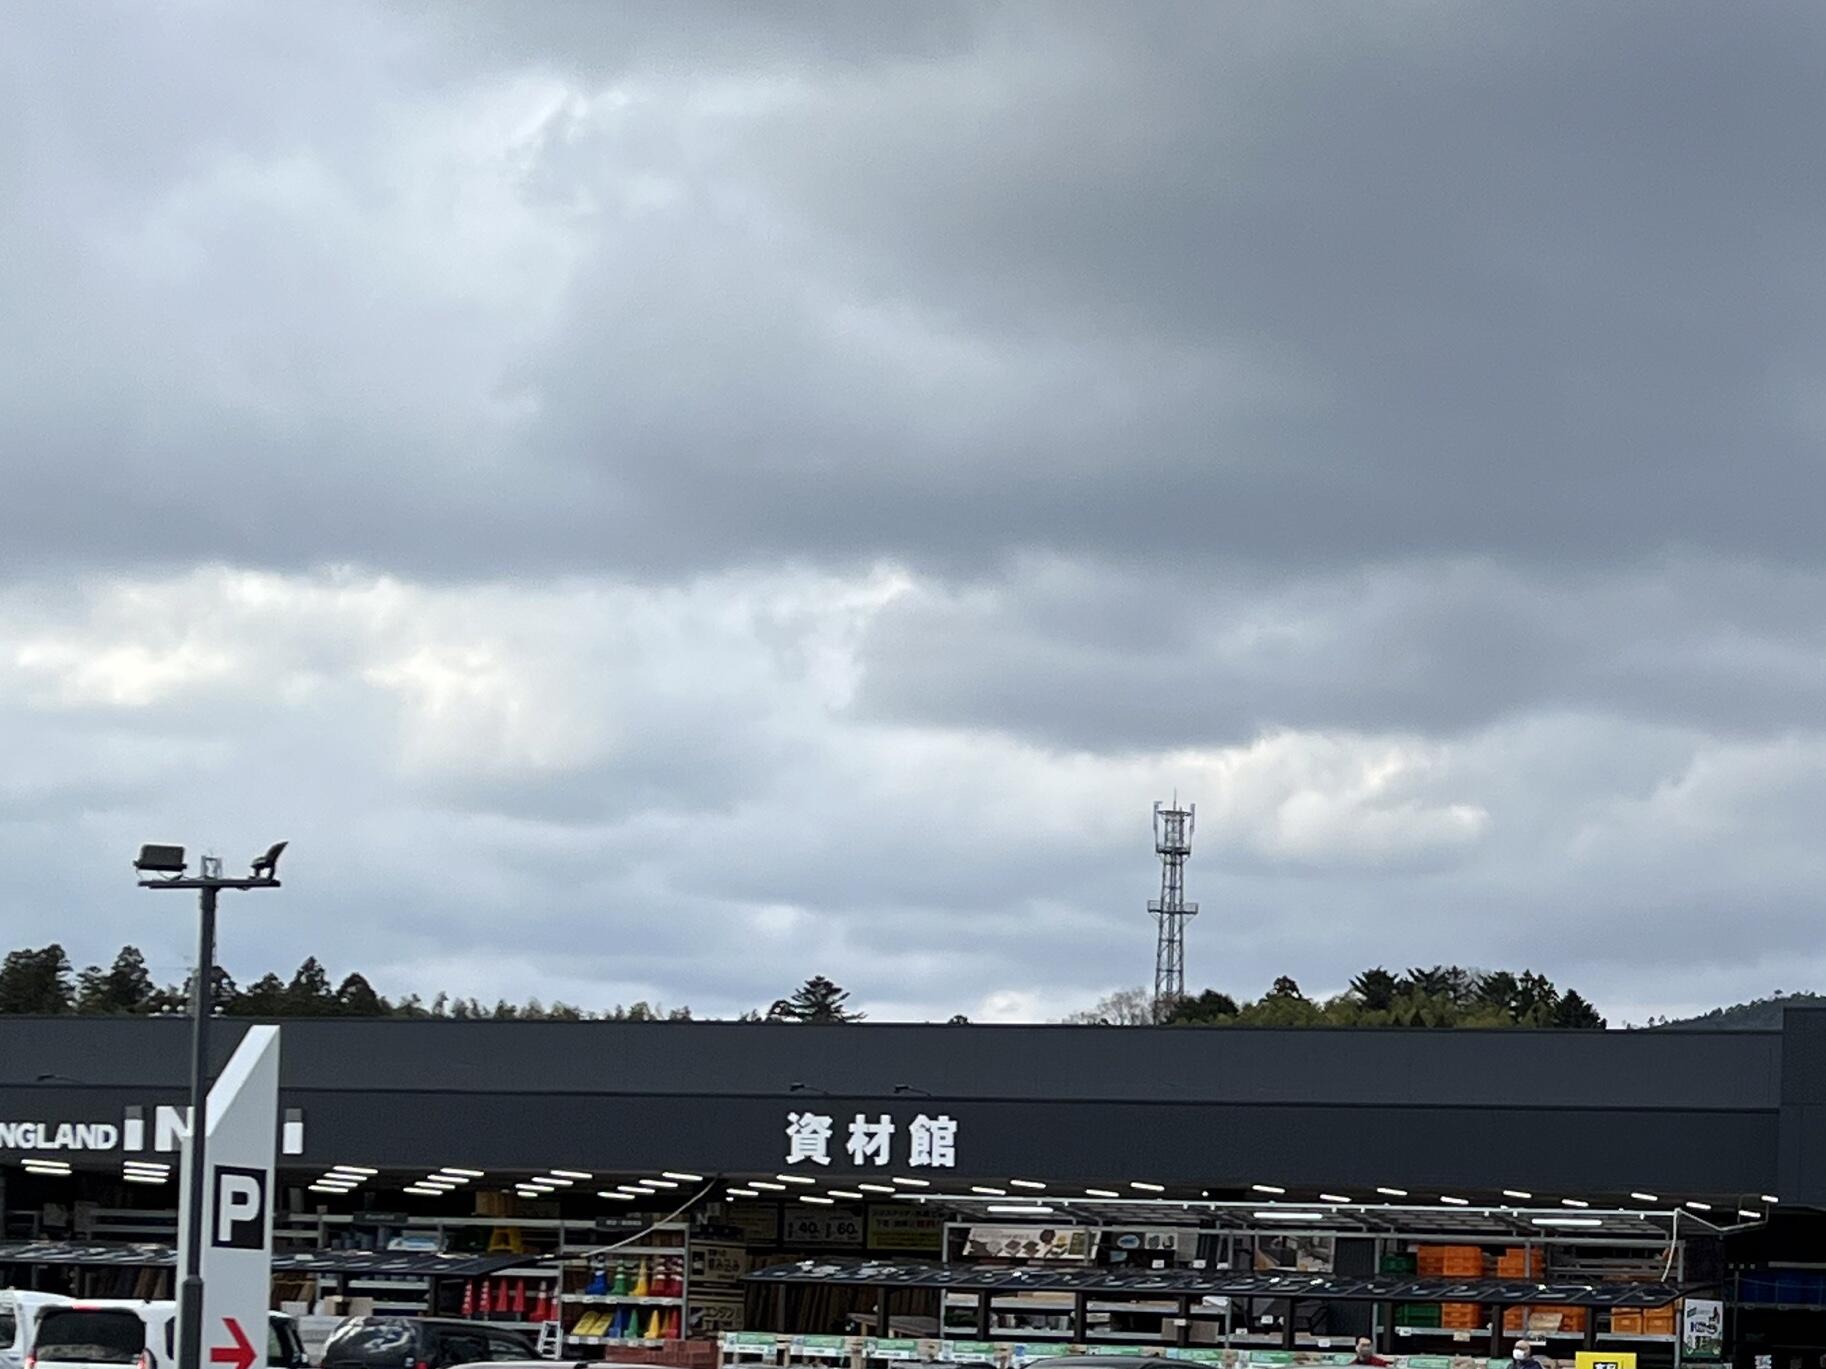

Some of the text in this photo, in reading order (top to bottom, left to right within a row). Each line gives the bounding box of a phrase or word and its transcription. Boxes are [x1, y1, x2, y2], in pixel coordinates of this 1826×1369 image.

[784, 1111, 959, 1168] 資材館
[217, 1174, 262, 1242] P
